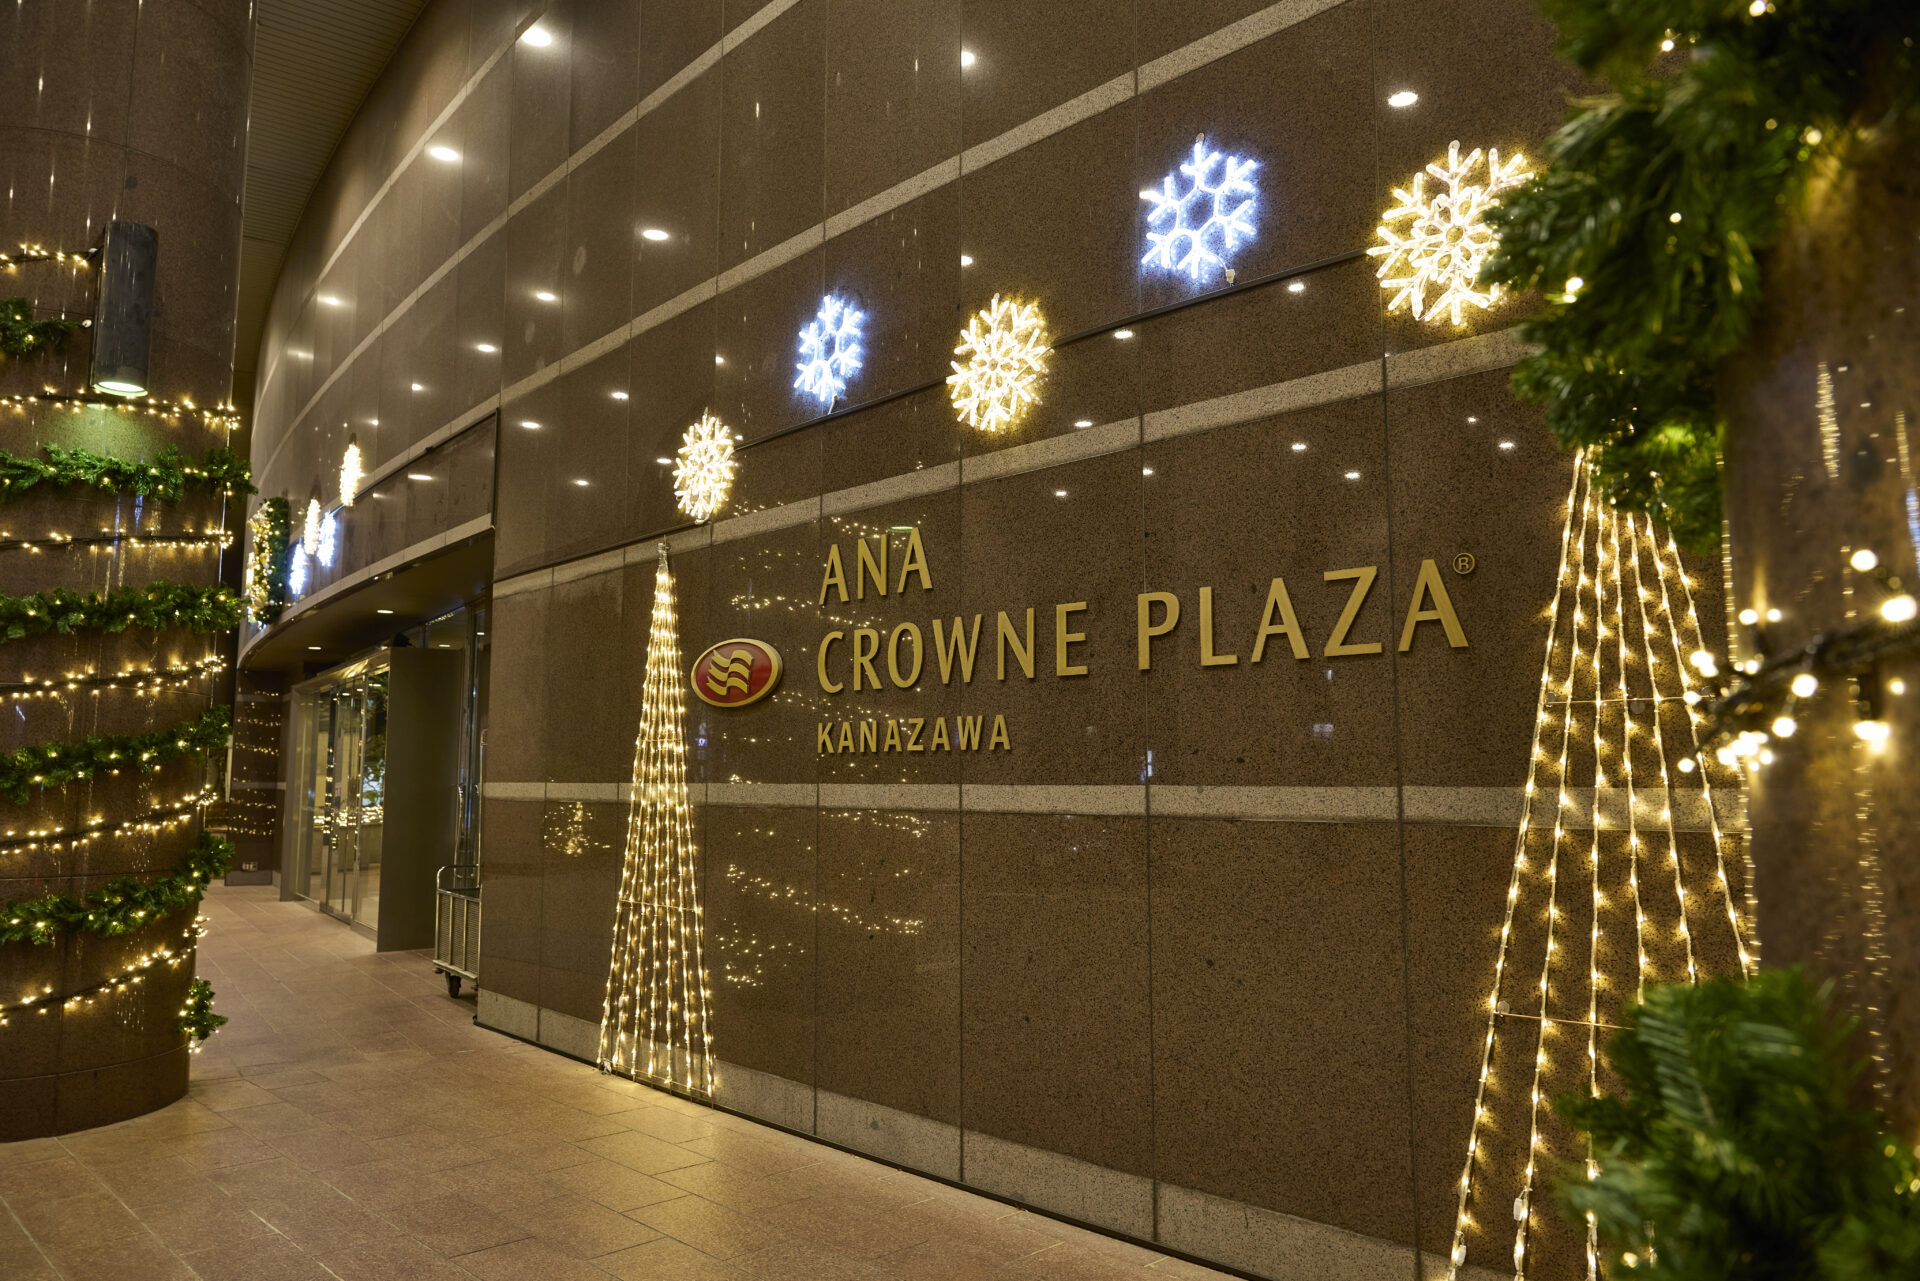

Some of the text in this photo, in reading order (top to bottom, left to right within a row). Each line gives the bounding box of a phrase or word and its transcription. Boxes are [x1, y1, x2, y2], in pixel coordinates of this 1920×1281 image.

[820, 527, 932, 604] ANA
[817, 602, 1087, 693] CROWNE
[817, 715, 1010, 753] KANAZAWA
